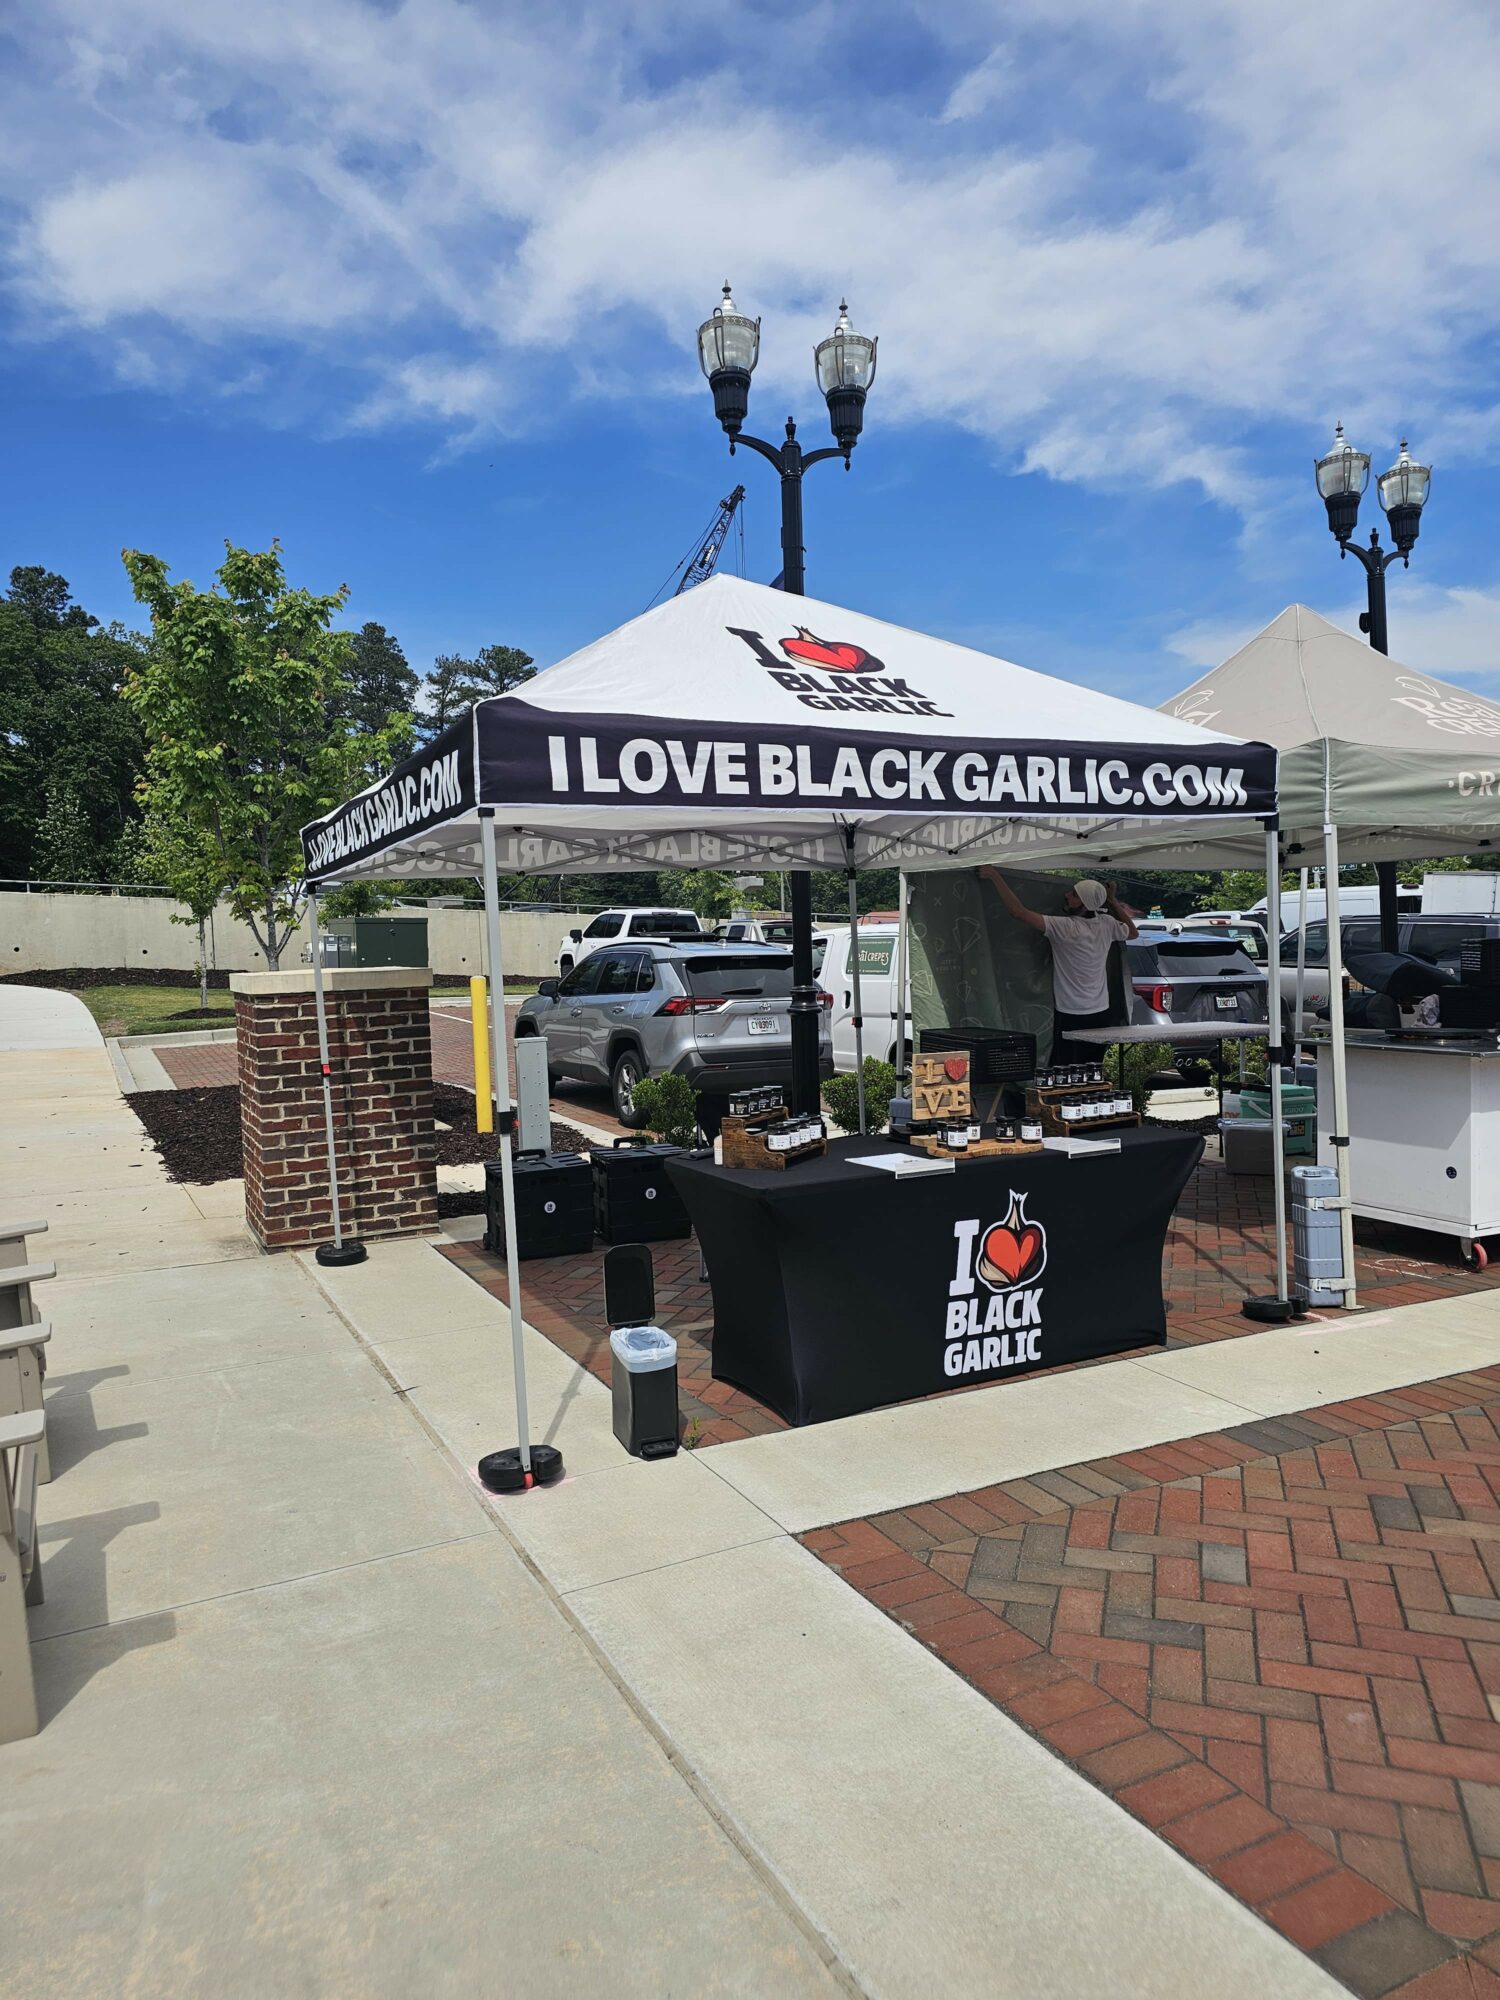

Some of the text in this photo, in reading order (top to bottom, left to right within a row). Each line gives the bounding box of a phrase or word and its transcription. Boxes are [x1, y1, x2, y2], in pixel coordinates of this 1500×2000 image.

[725, 626, 796, 670] I
[767, 670, 928, 699] BLACK
[797, 694, 955, 717] GARLIC
[548, 735, 1248, 807] I LOVE BLACK GARLIC.COM
[311, 827, 336, 871] LOVE
[335, 804, 369, 860] BLACK
[365, 749, 462, 842] GARLIC.COM
[949, 1219, 980, 1296] I
[945, 1288, 1044, 1339] BLACK
[944, 1328, 1042, 1377] GARLIC
